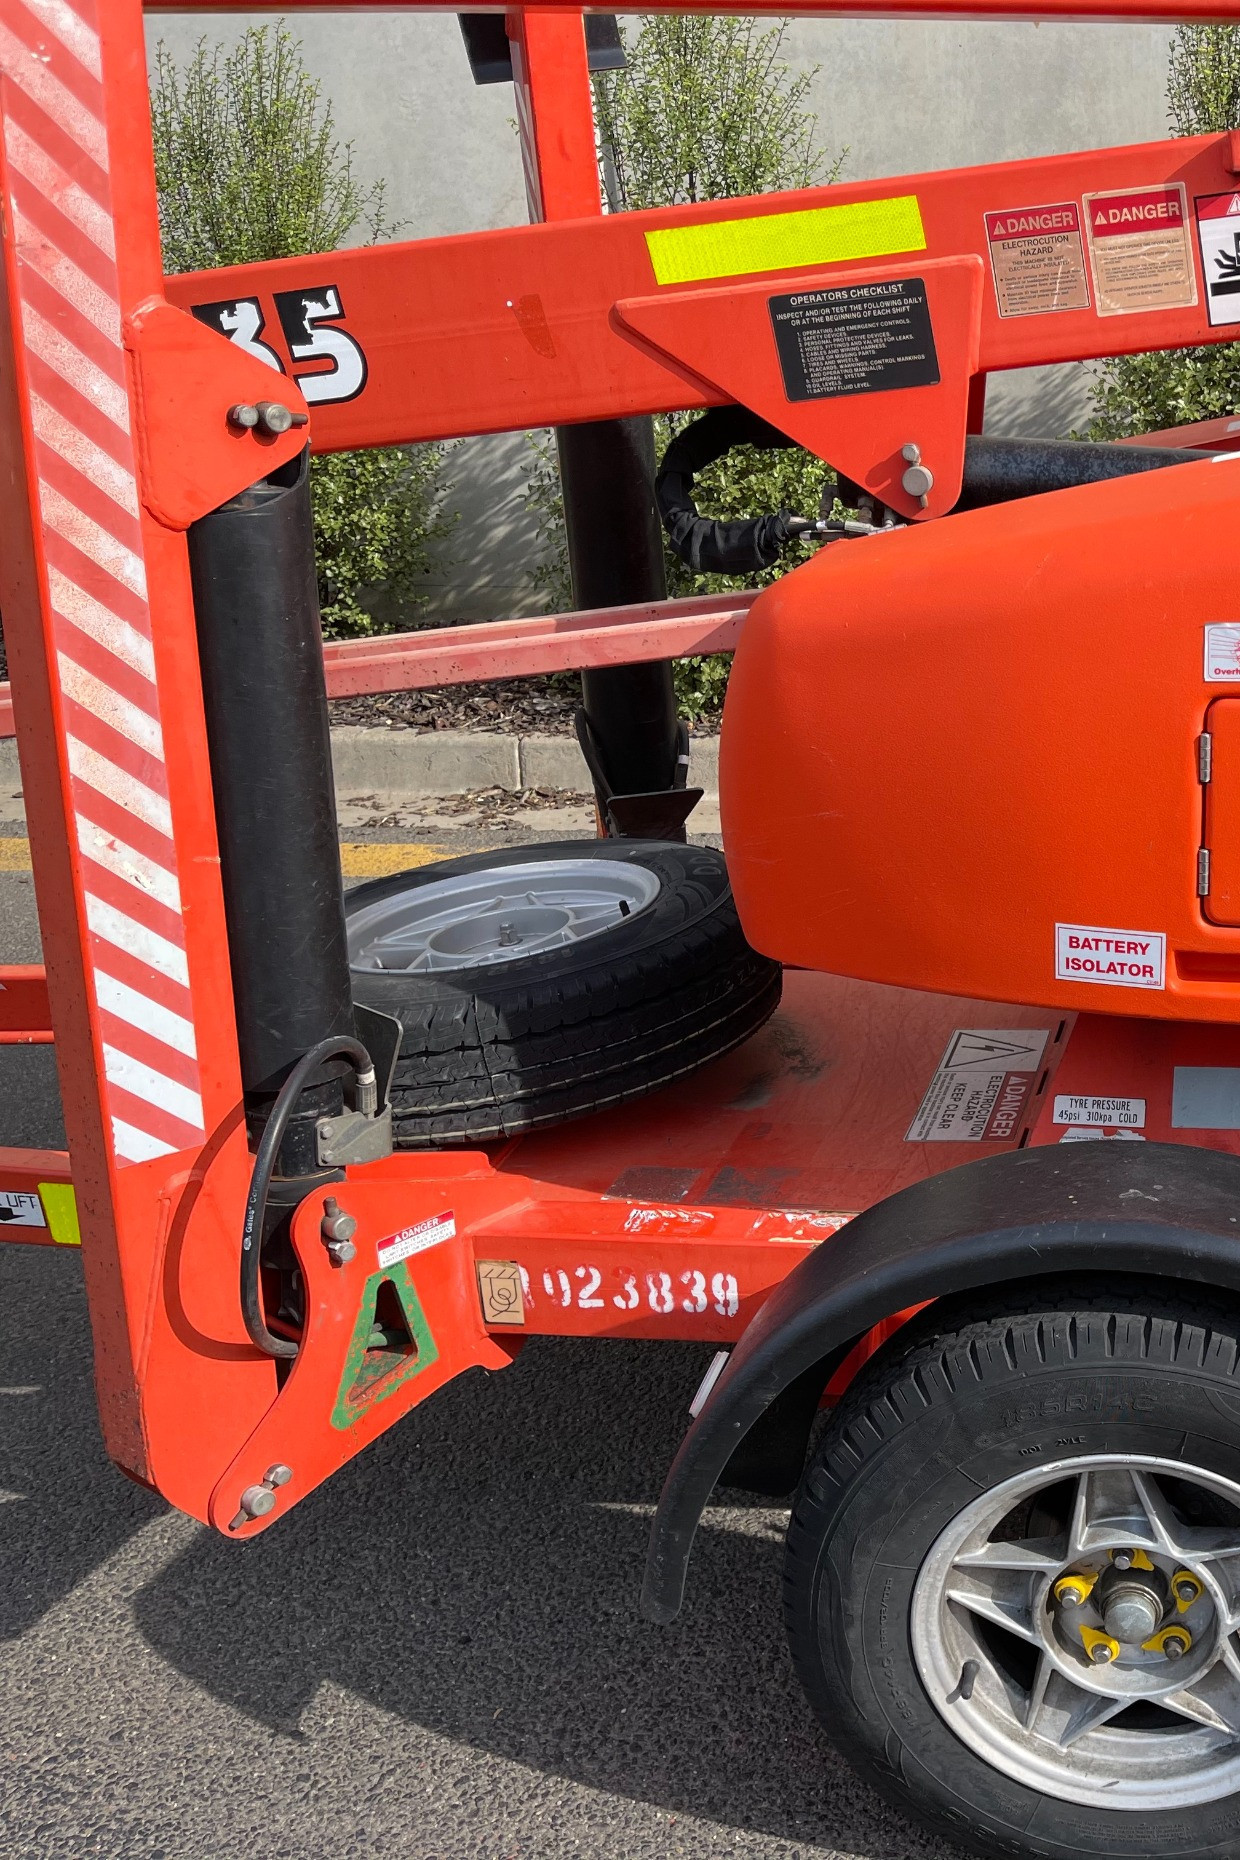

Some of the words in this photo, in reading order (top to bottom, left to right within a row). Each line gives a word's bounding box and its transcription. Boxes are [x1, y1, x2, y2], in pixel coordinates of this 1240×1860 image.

[1006, 211, 1073, 233] DANGER
[1109, 202, 1180, 223] DANGER
[1002, 235, 1069, 250] ELECTROCUTION
[1020, 246, 1053, 257] HAZARD
[790, 291, 848, 305] OPERATORS
[850, 284, 903, 298] CHECKLIST
[776, 311, 803, 320] INSPECT
[805, 308, 830, 316] AND/OR
[831, 305, 848, 313] TEST
[849, 303, 863, 311] THE
[863, 299, 902, 309] FOLLOWING
[903, 296, 922, 305] DAILY
[811, 316, 824, 324] THE
[825, 312, 862, 322] BEGINNING
[862, 310, 871, 318] OF
[873, 308, 891, 317] EACH
[892, 305, 910, 314] SHIFT
[846, 321, 879, 332] EMERGENCY
[1069, 935, 1150, 956] BATTERY
[1065, 957, 1154, 978] ISOLATOR
[950, 1082, 968, 1102] KEEP
[961, 1090, 984, 1122] HAZARD
[968, 1075, 1003, 1138] ELECTROCUTION
[988, 1084, 1027, 1138] DANGER
[1070, 1098, 1088, 1109] TYRE
[1092, 1099, 1131, 1112] PRESSURE
[937, 1104, 959, 1130] CLEAR
[1058, 1109, 1080, 1122] 45psi
[1086, 1111, 1113, 1124] 310kpa
[1118, 1113, 1138, 1124] COLD
[6, 1194, 36, 1209] LIFT
[401, 1218, 439, 1240] DANGER
